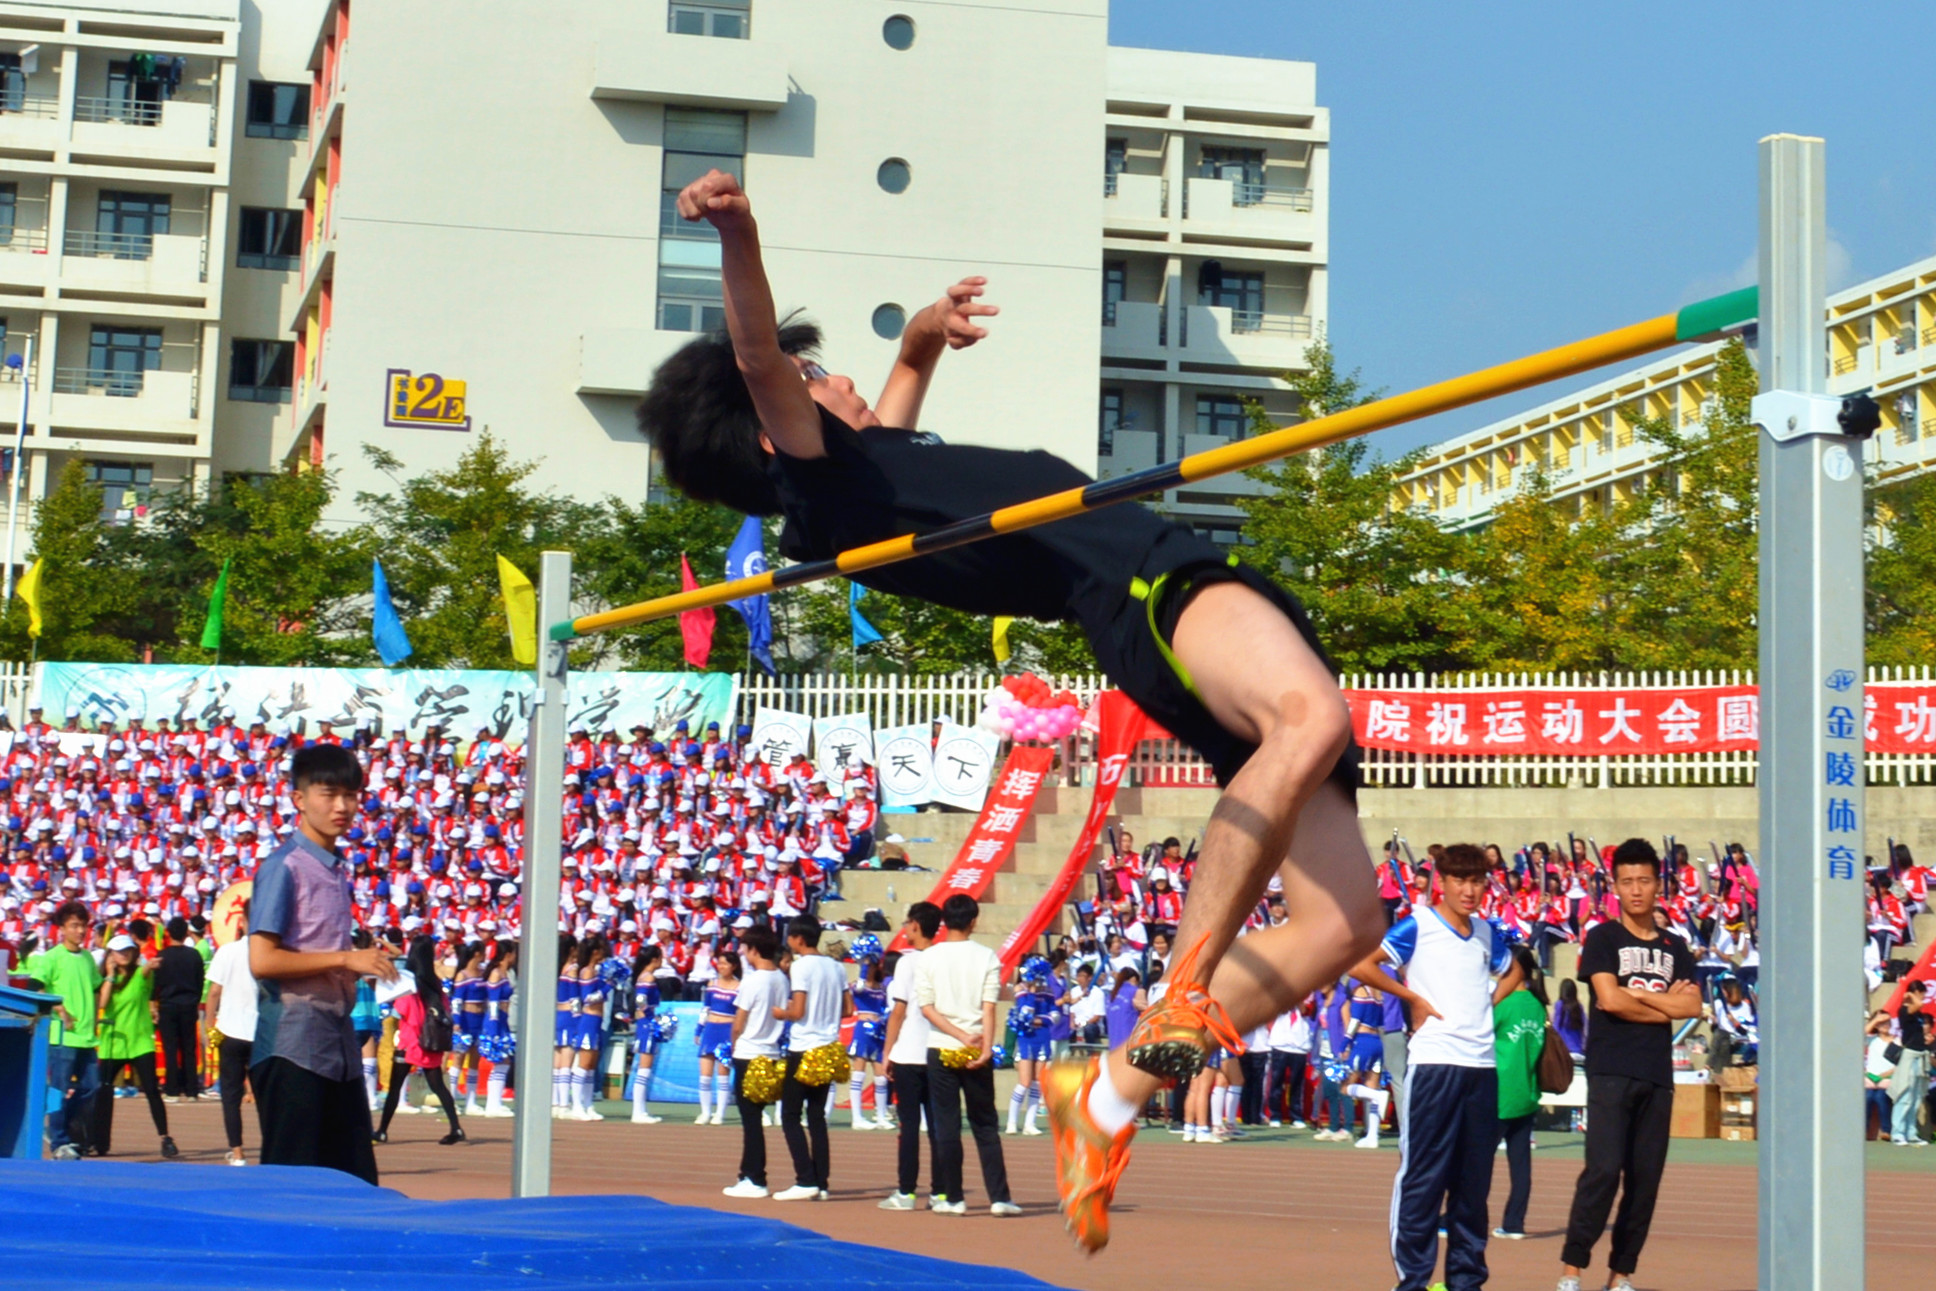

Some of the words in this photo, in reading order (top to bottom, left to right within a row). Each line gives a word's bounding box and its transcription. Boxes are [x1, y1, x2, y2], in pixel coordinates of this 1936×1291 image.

[947, 767, 1041, 890] 挥洒青春
[1825, 705, 1858, 880] 金陵体育
